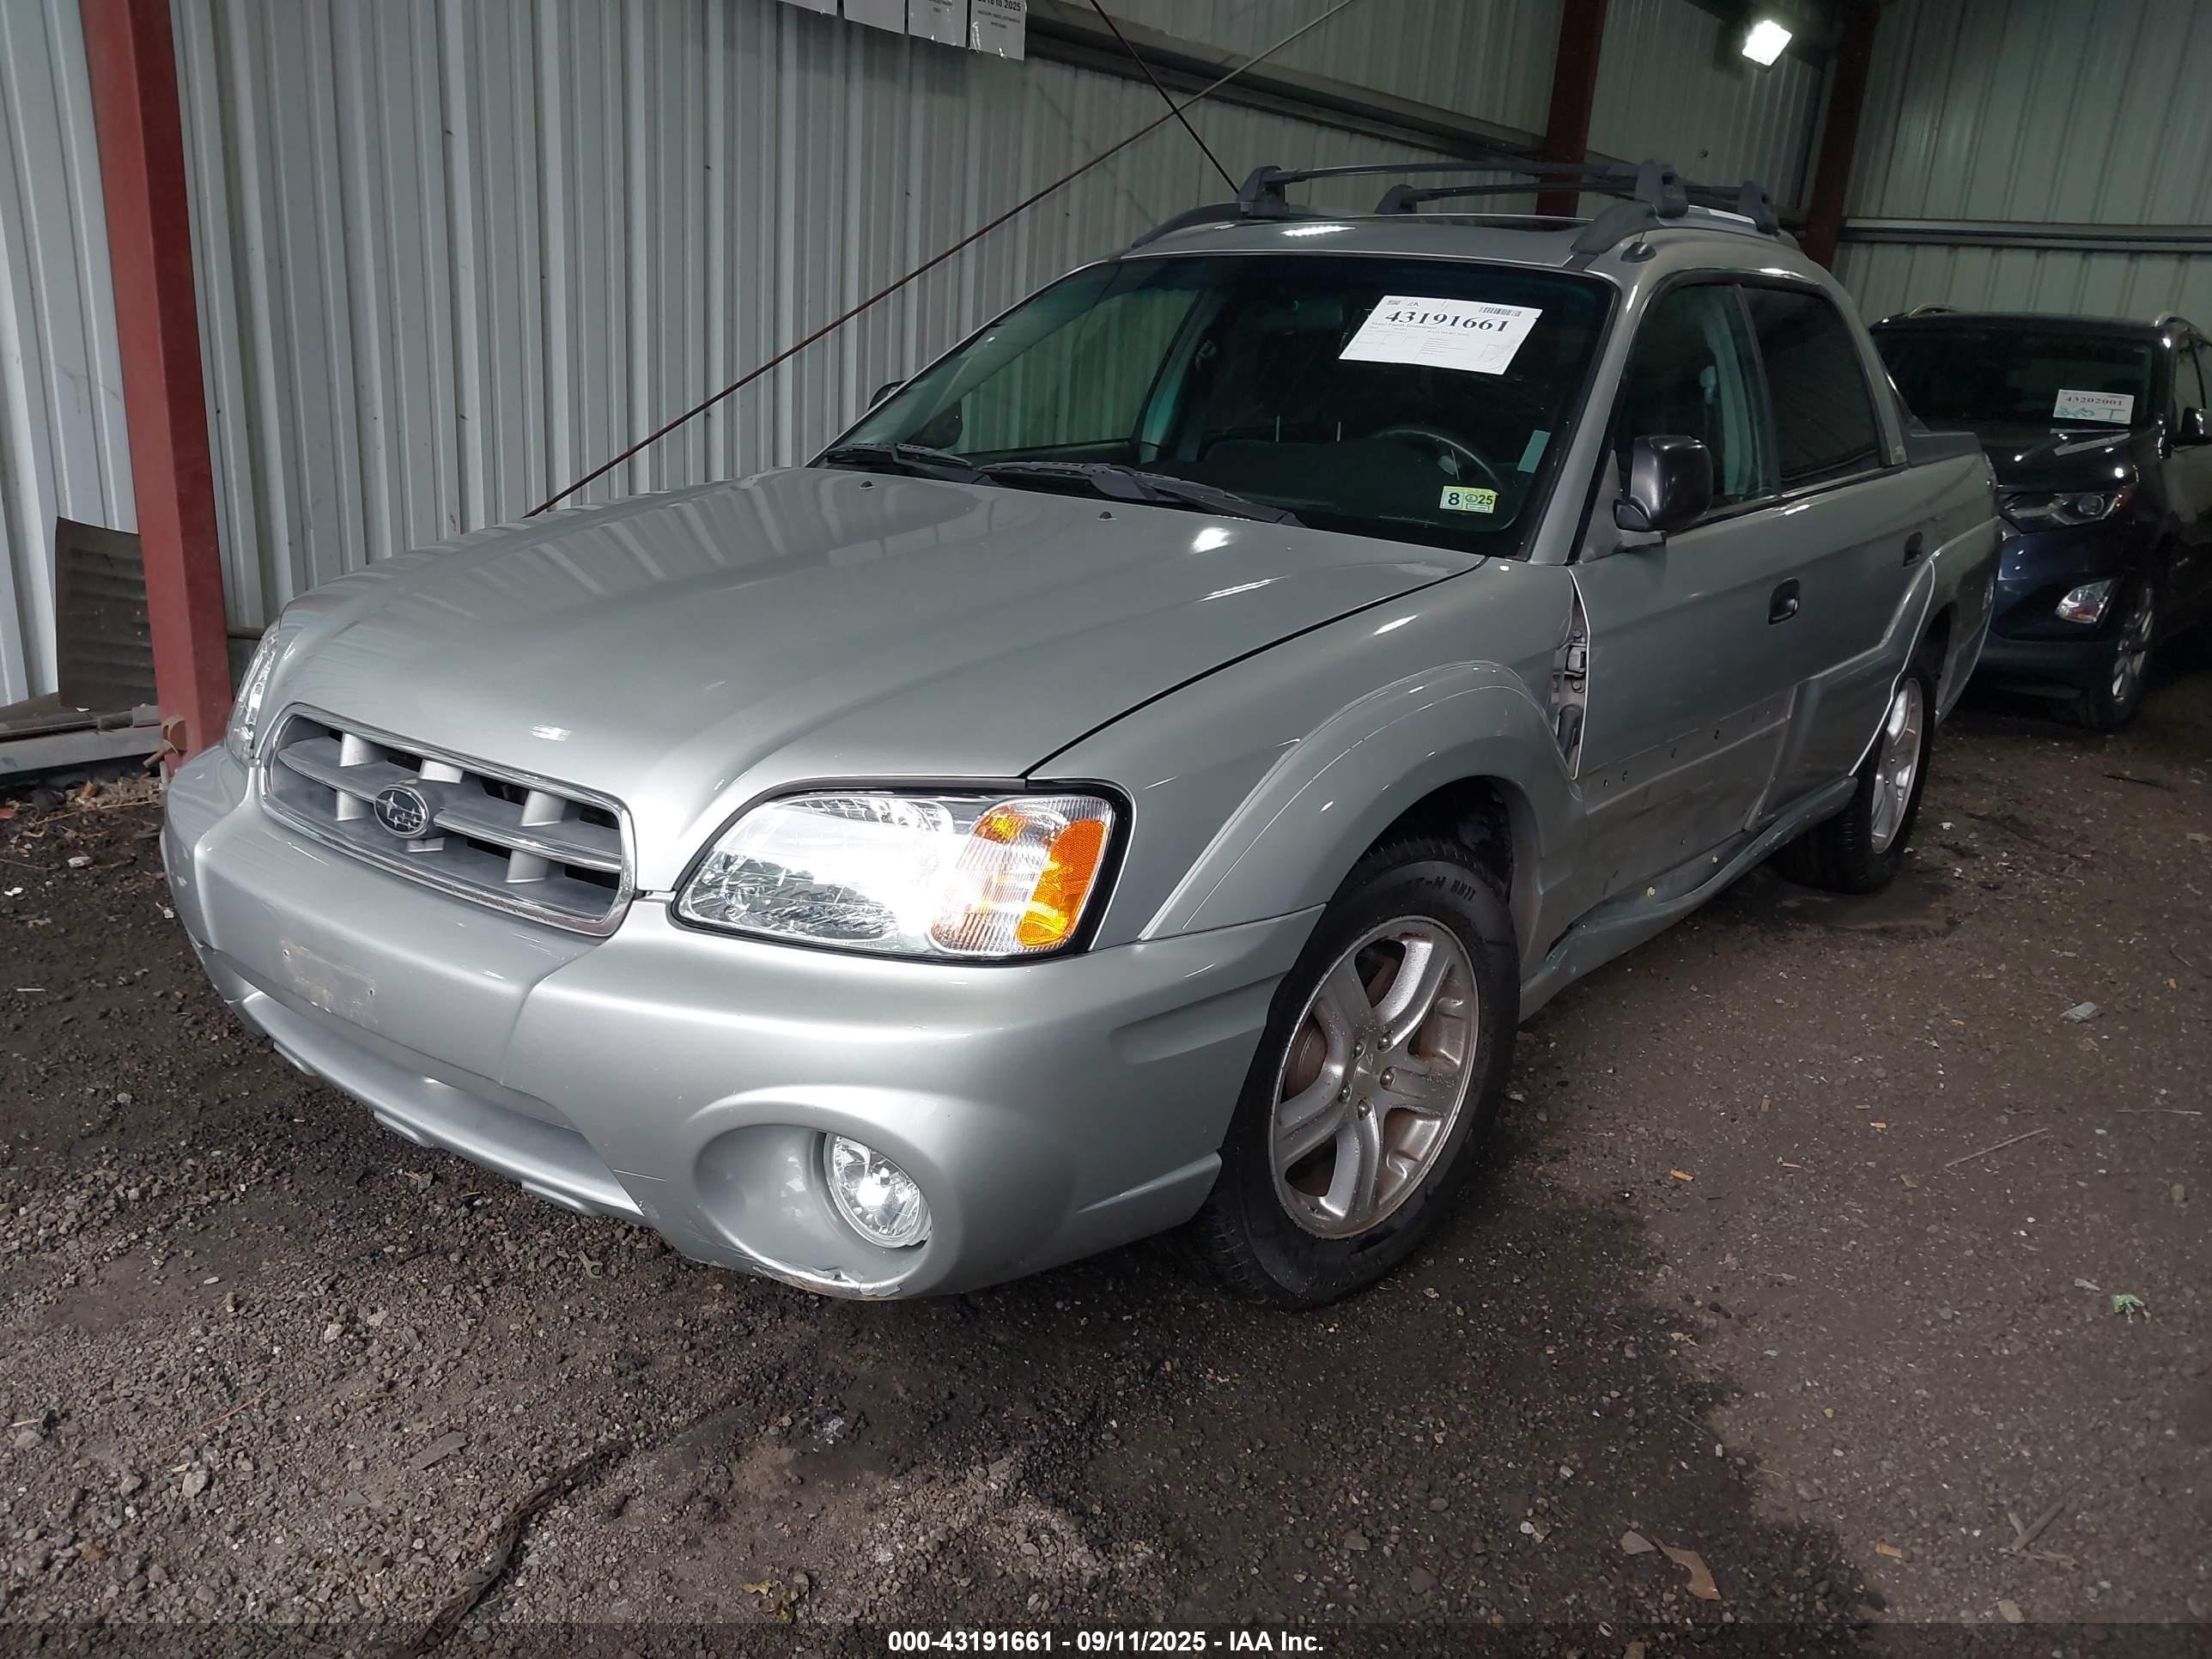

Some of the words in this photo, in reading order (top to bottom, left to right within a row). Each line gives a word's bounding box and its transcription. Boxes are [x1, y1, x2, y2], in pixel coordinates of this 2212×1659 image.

[1004, 0, 1021, 11] 2025
[1385, 310, 1509, 332] 43191661
[1448, 492, 1460, 506] 8
[1477, 494, 1494, 506] 25
